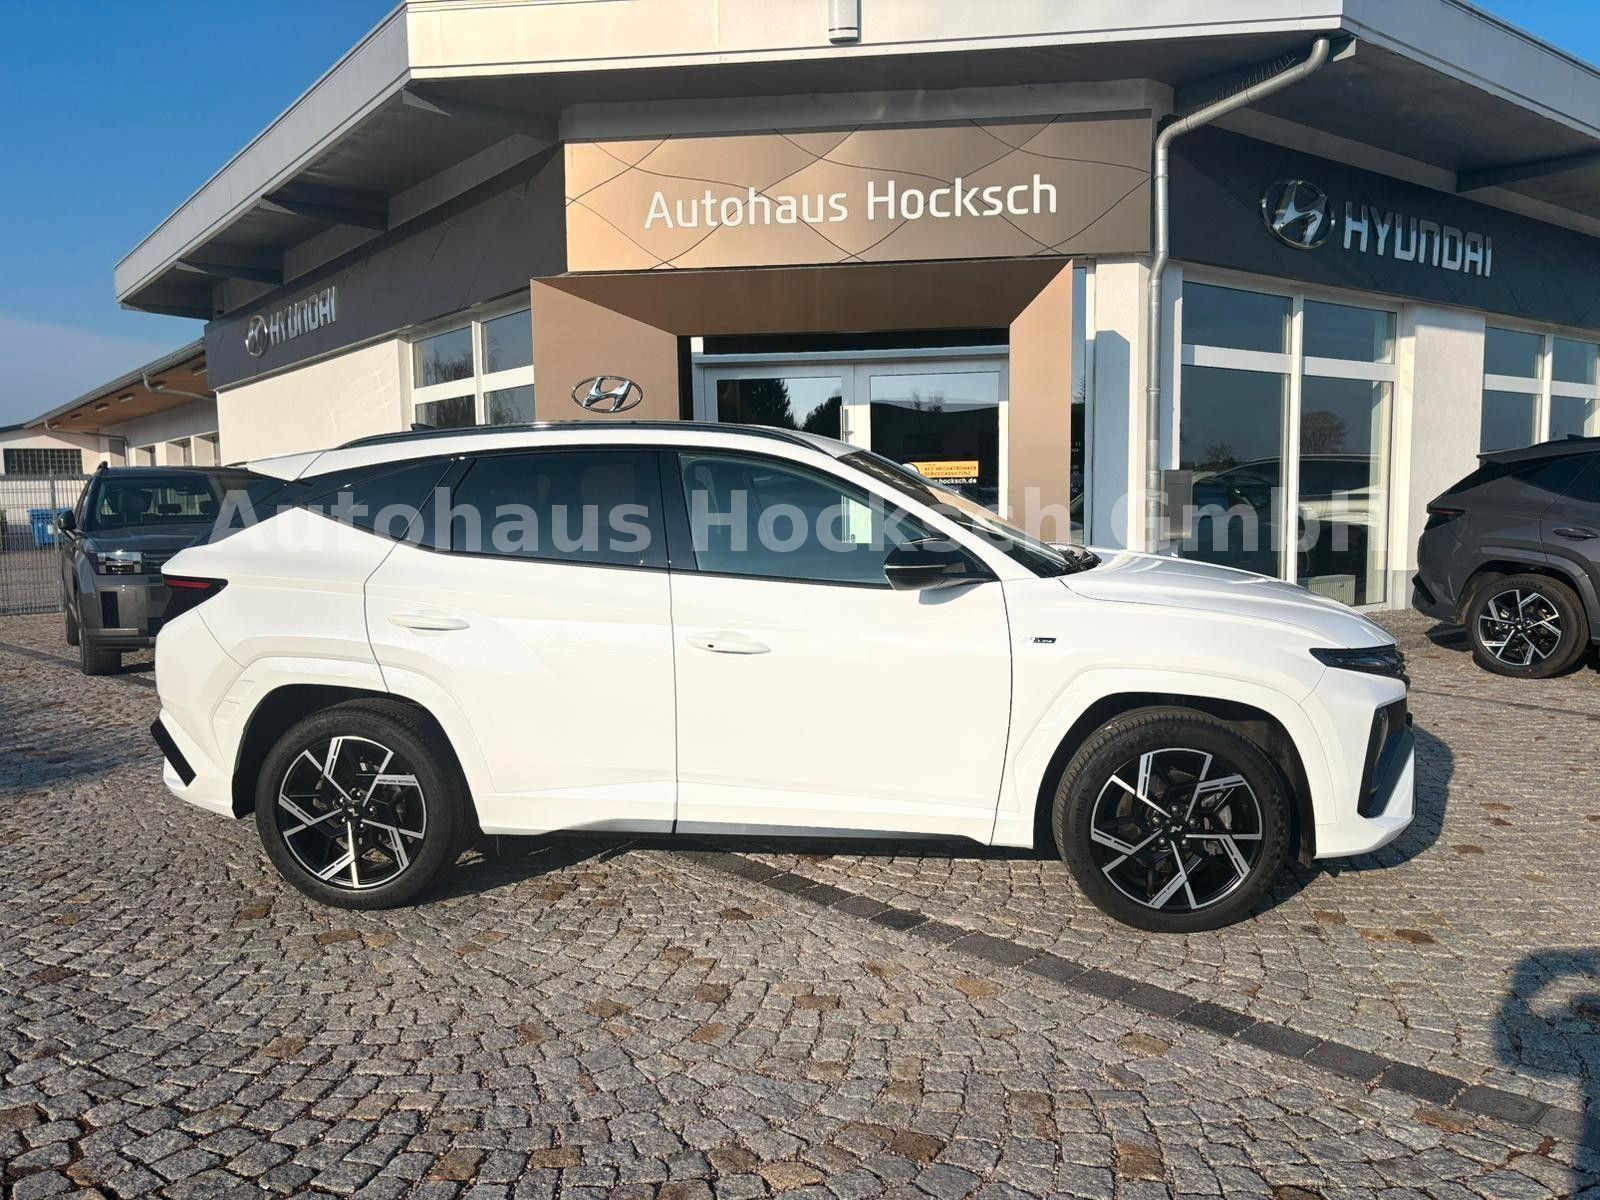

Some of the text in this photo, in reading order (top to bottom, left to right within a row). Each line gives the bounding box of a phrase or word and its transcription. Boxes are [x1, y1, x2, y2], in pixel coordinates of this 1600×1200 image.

[643, 174, 1057, 229] Autohaus Hocksch
[1343, 200, 1493, 278] HYUNDAI
[269, 286, 336, 346] HYUNDAI
